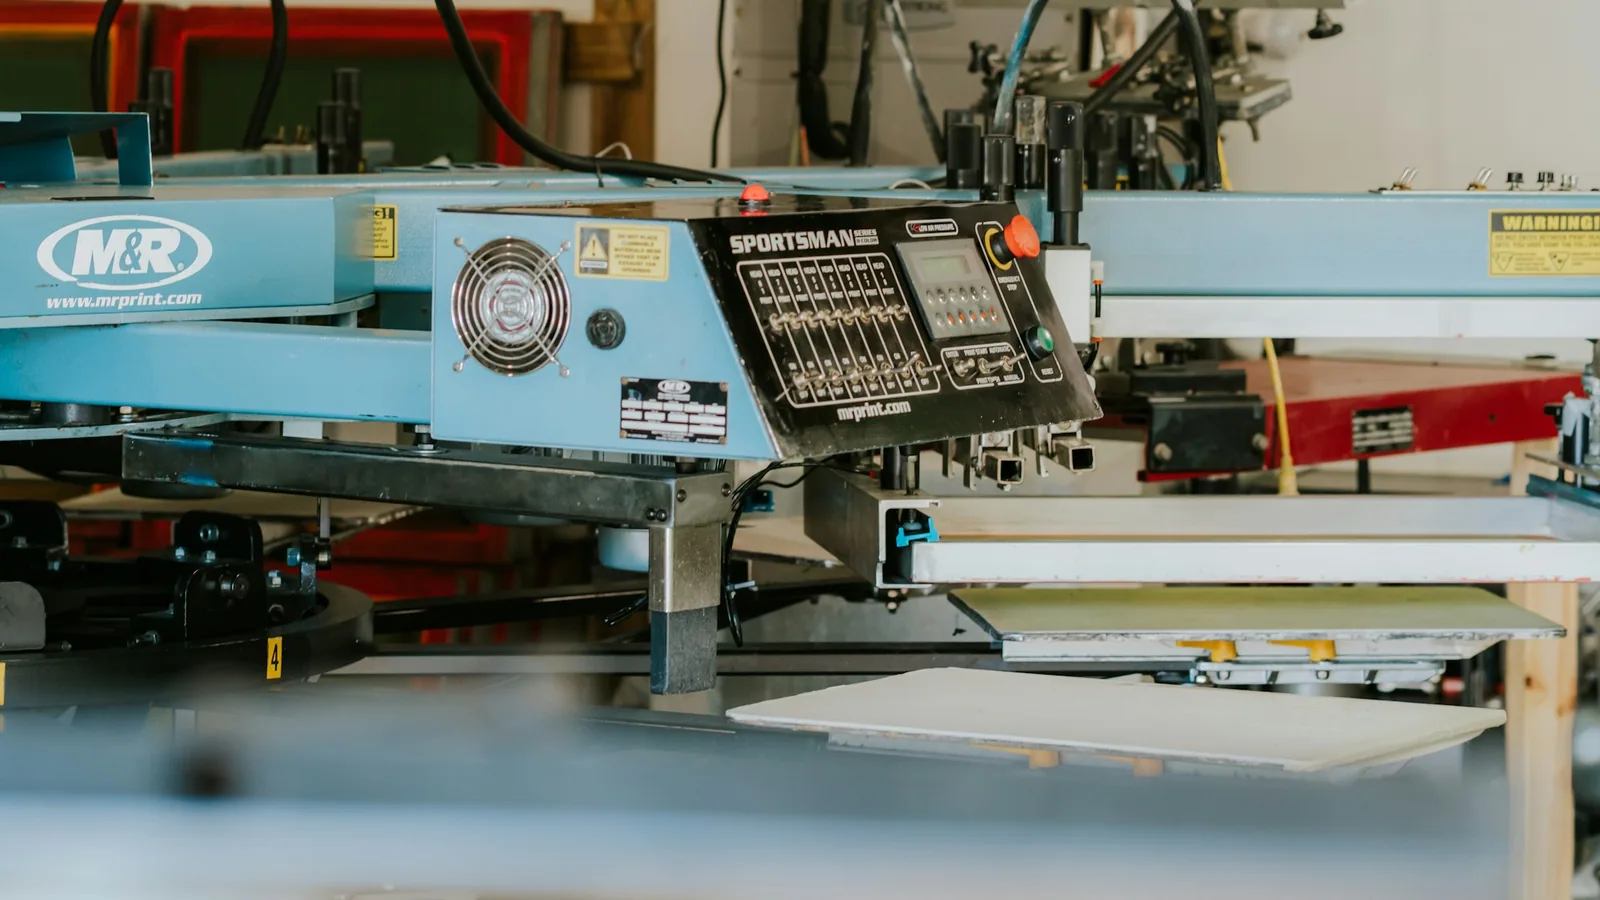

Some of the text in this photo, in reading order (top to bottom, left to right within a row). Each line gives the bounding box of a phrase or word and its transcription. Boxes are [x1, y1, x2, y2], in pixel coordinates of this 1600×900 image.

[1502, 215, 1600, 231] WARNING!
[71, 227, 182, 275] M&R
[730, 229, 854, 254] SPORTSMAN
[46, 292, 202, 310] www.mrprint.com
[837, 401, 911, 422] mrprint.com
[271, 644, 279, 671] 4
